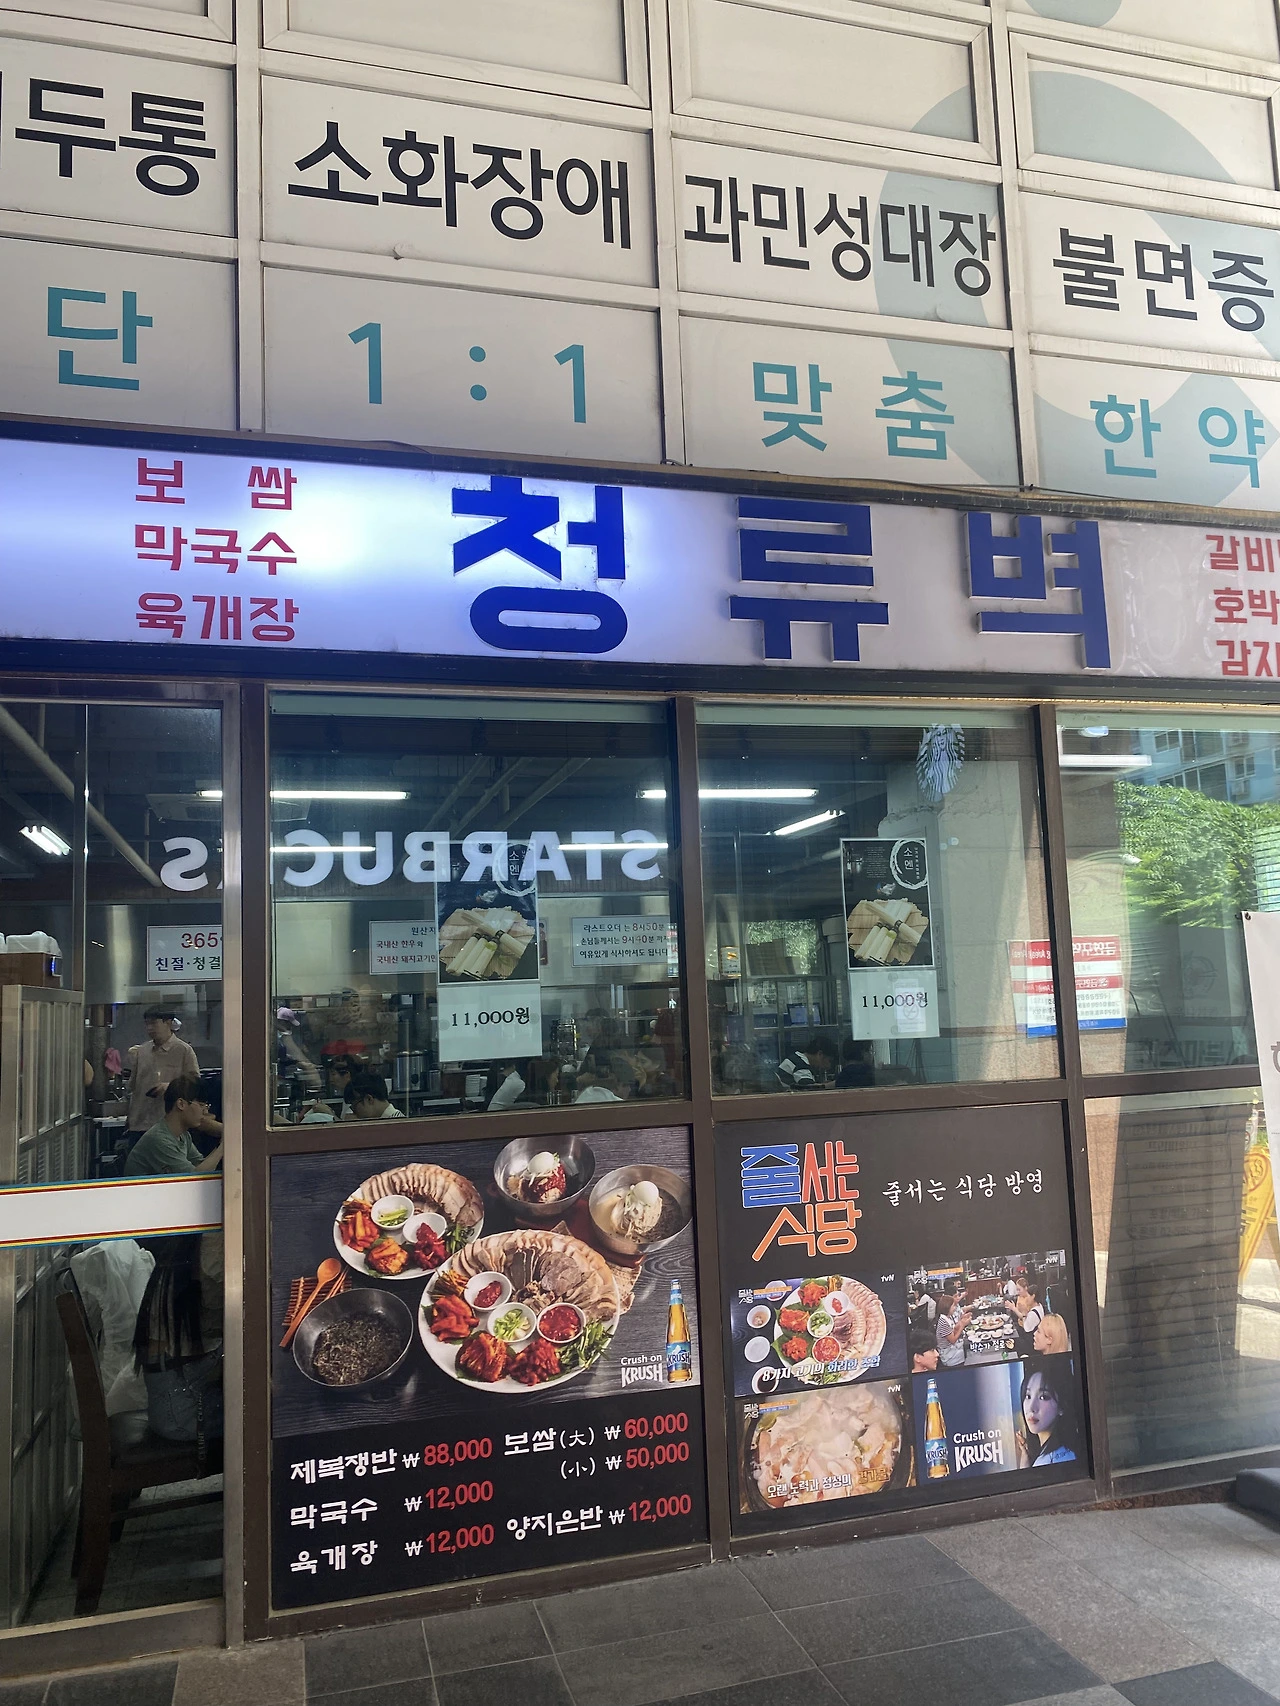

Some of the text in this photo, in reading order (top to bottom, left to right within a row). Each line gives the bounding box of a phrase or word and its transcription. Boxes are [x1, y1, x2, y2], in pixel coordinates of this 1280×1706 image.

[0, 71, 216, 196] 두통
[287, 121, 631, 249] 소화장애
[684, 173, 997, 297] 과민성대장
[1053, 227, 1275, 332] 불면증
[47, 286, 154, 391] 단
[135, 524, 297, 576] 막국수
[1206, 535, 1280, 572] 갈비
[136, 592, 299, 642] 육개장
[181, 932, 223, 949] 365
[376, 940, 398, 949] 국내산
[377, 955, 398, 964] 국내산
[861, 991, 929, 1010] 11,000원
[882, 1168, 1043, 1207] 줄서는 식당 방영
[751, 1200, 862, 1262] 식당
[881, 1274, 895, 1282] tvN
[620, 1354, 662, 1366] Crush on
[621, 1362, 664, 1388] KRUSH
[666, 1350, 691, 1368] KRUSH
[953, 1428, 1002, 1444] Crush on
[290, 1448, 398, 1484] 제복쟁반
[955, 1440, 1004, 1473] KRUSH
[290, 1497, 378, 1530] 막국수
[290, 1540, 379, 1575] 육개장
